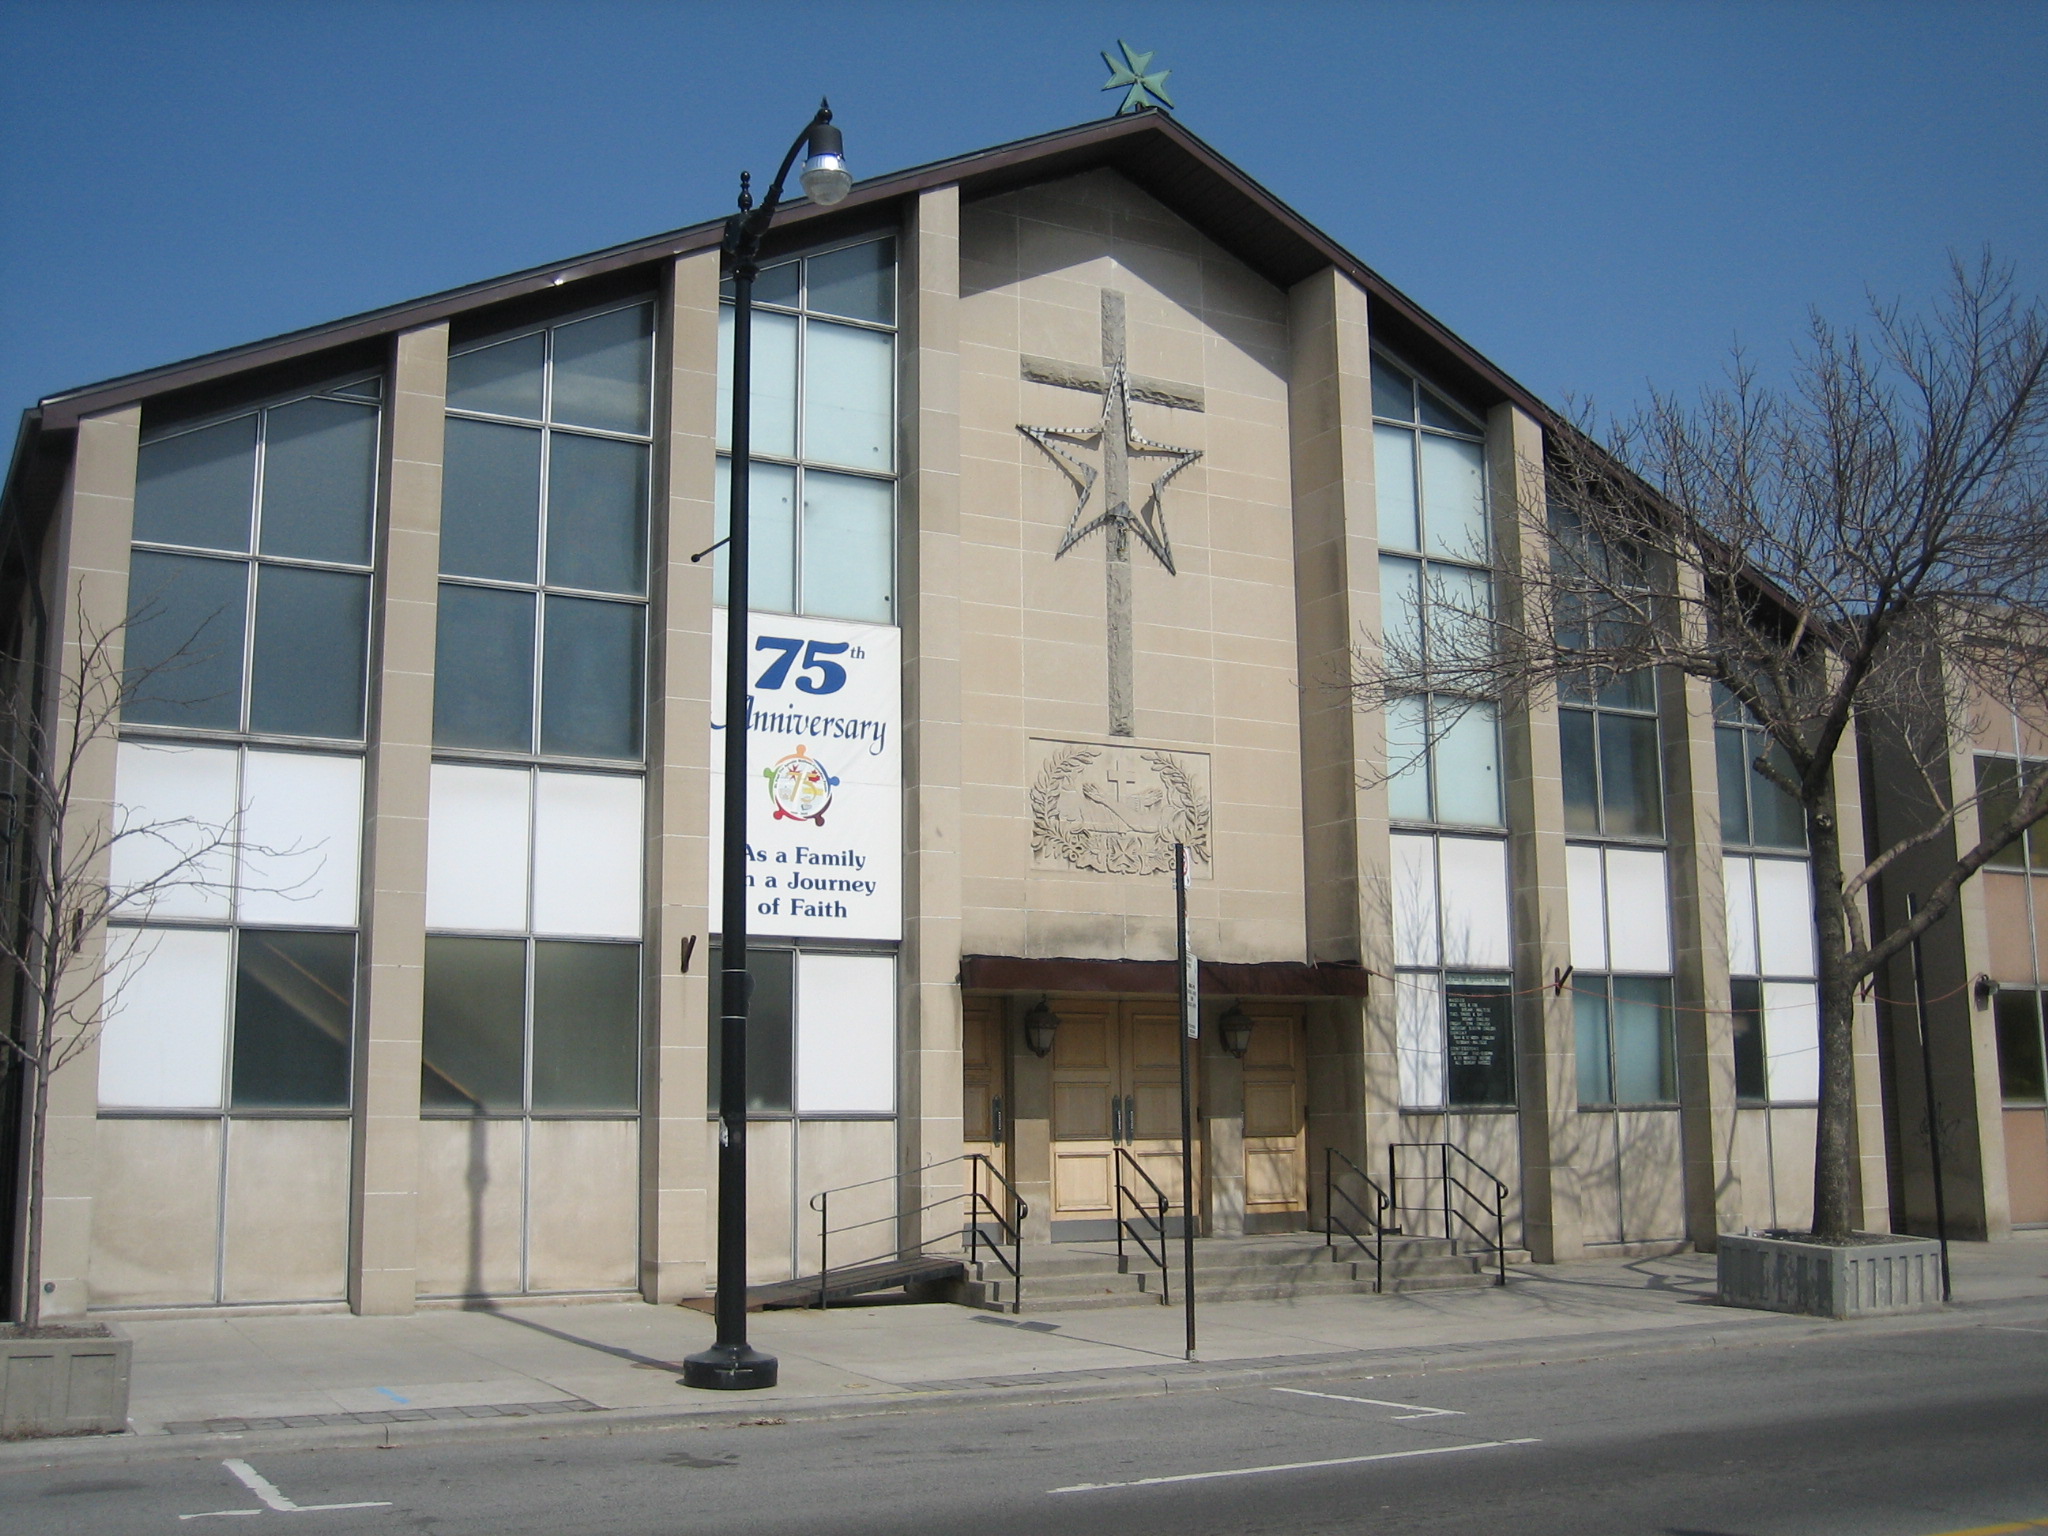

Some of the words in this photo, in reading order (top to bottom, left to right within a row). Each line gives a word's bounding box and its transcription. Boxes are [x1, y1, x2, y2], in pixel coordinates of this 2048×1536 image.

[755, 635, 866, 696] 75th
[775, 851, 788, 864] a
[795, 846, 867, 871] Family
[764, 875, 778, 889] a
[787, 871, 877, 897] Journey
[757, 897, 781, 916] of
[790, 898, 848, 919] Faith
